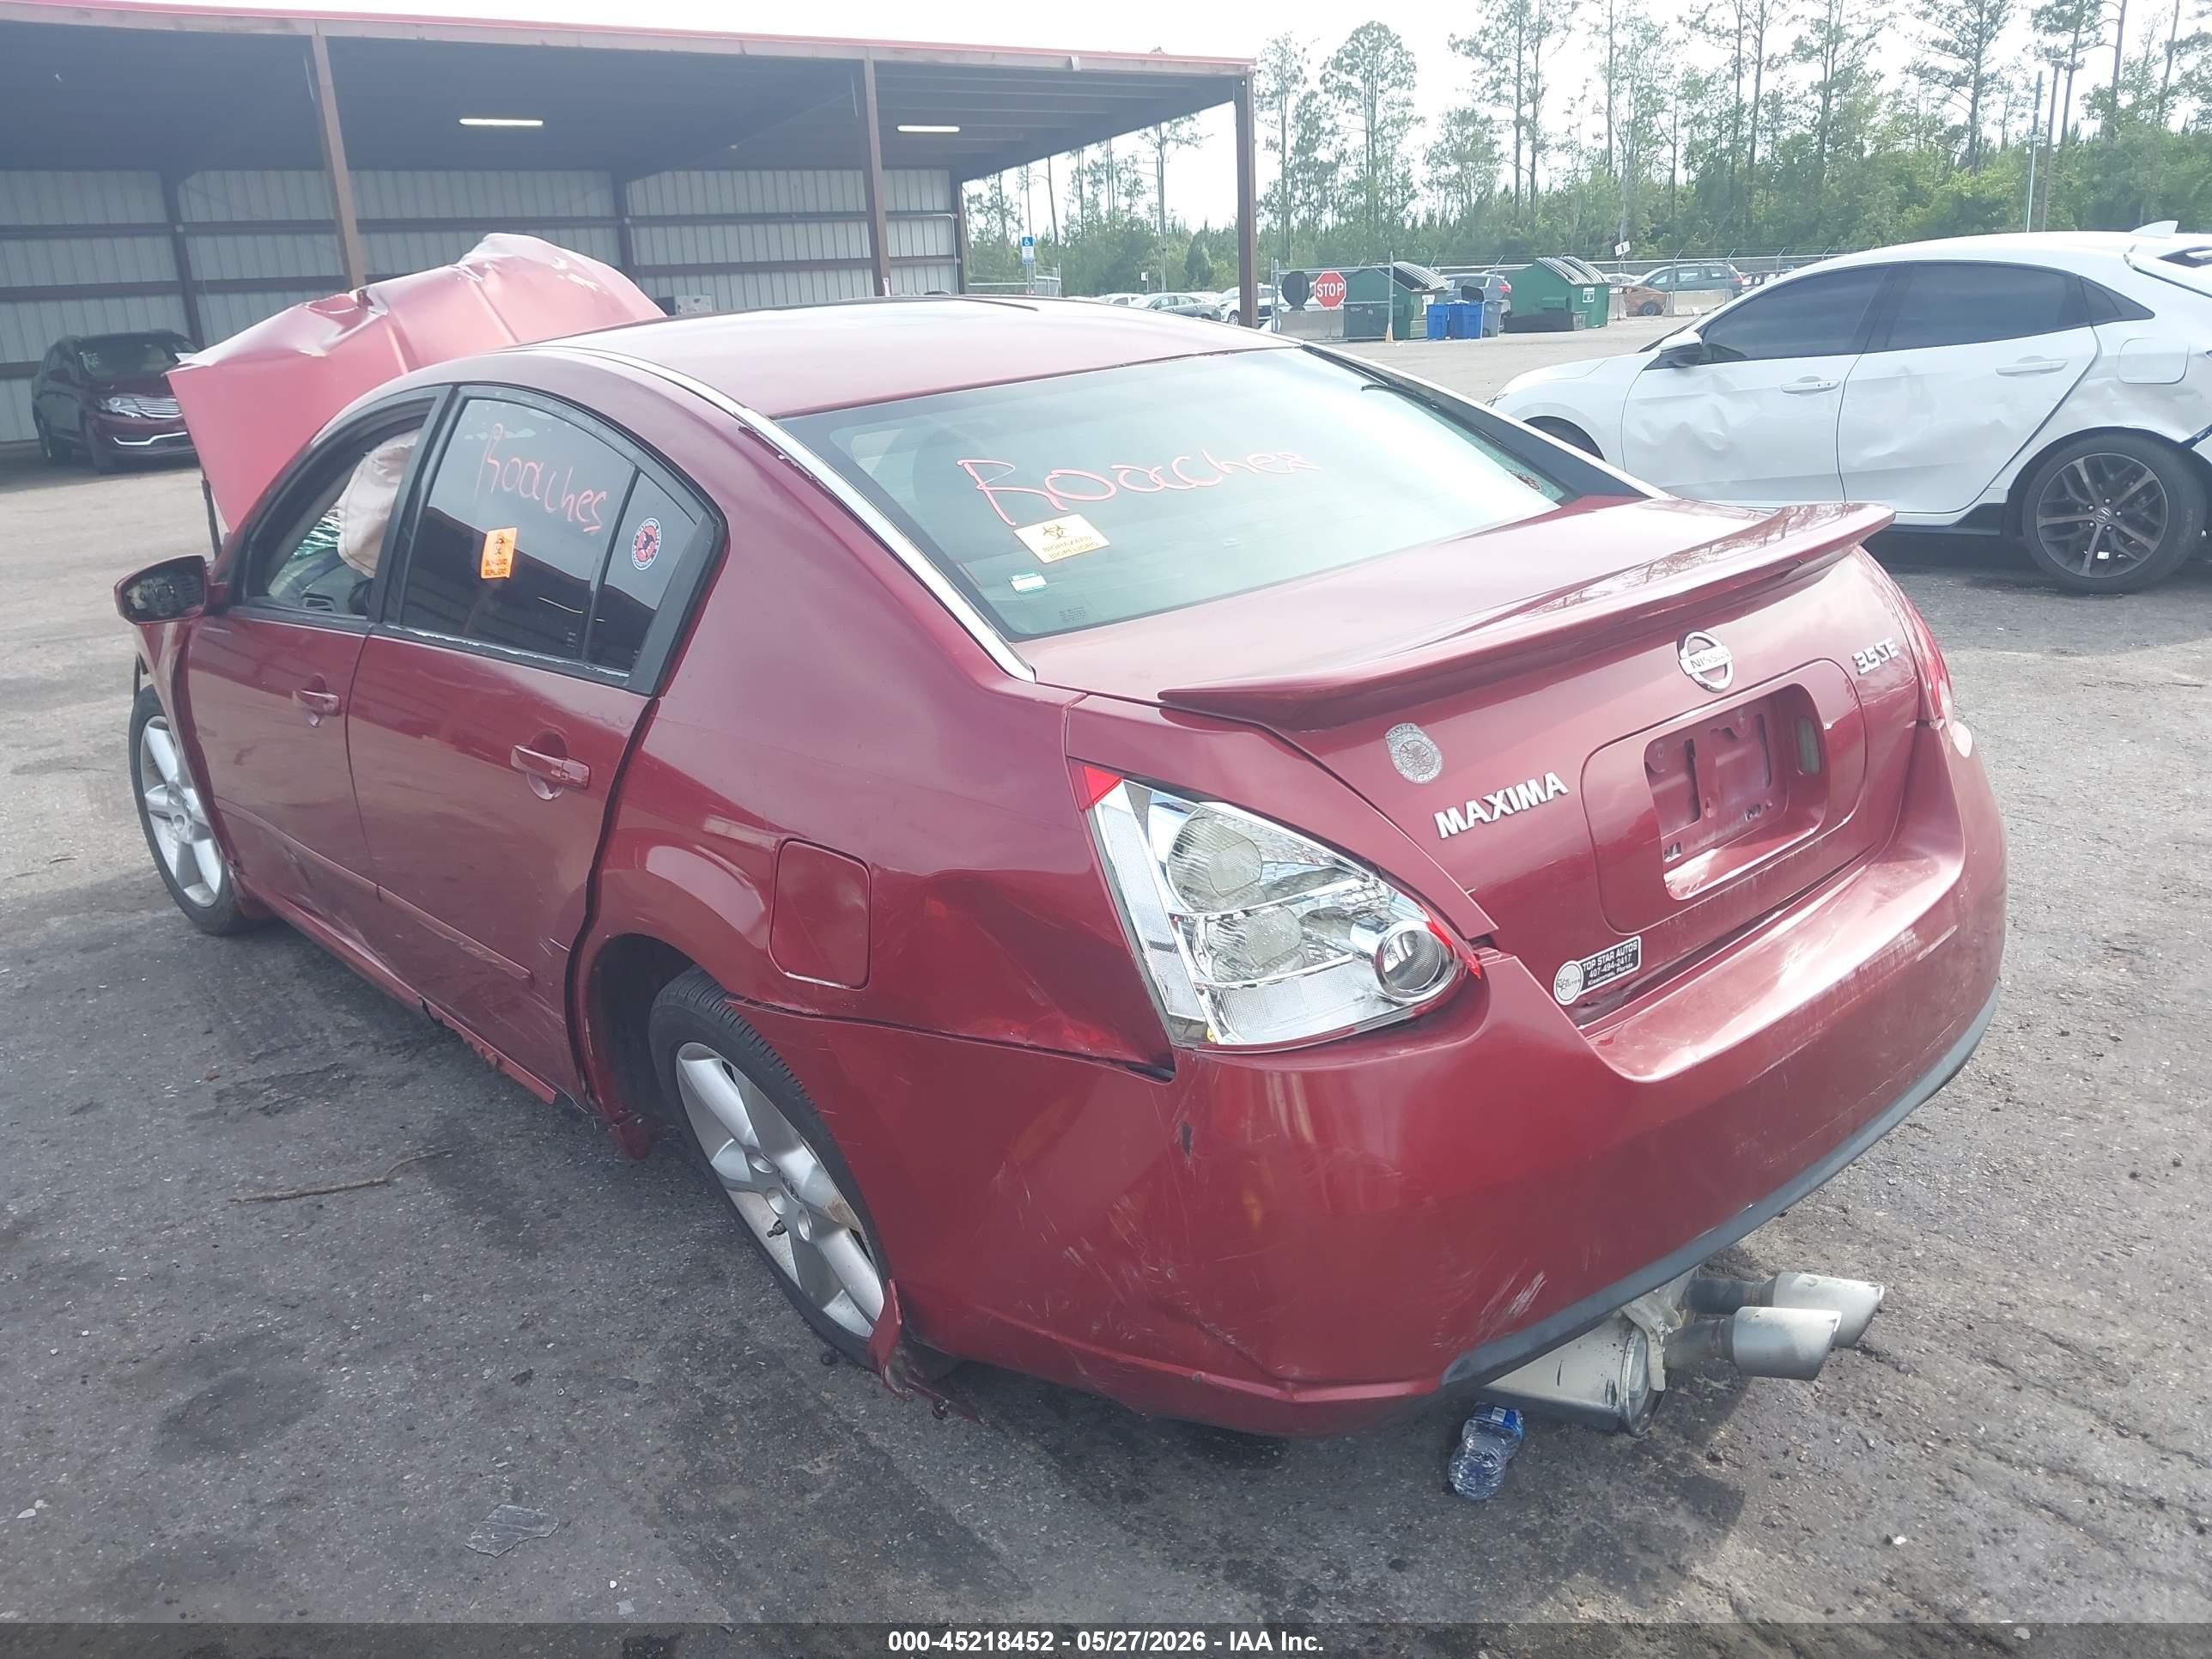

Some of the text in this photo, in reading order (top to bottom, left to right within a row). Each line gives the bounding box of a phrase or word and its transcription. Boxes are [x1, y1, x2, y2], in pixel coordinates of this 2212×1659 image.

[1316, 283, 1345, 297] STOP
[474, 423, 607, 532] Roaches
[1433, 771, 1570, 839] MAXIMA
[1582, 940, 1638, 972] TOP STAR AUTOS
[1589, 953, 1632, 978] 407-494-2417
